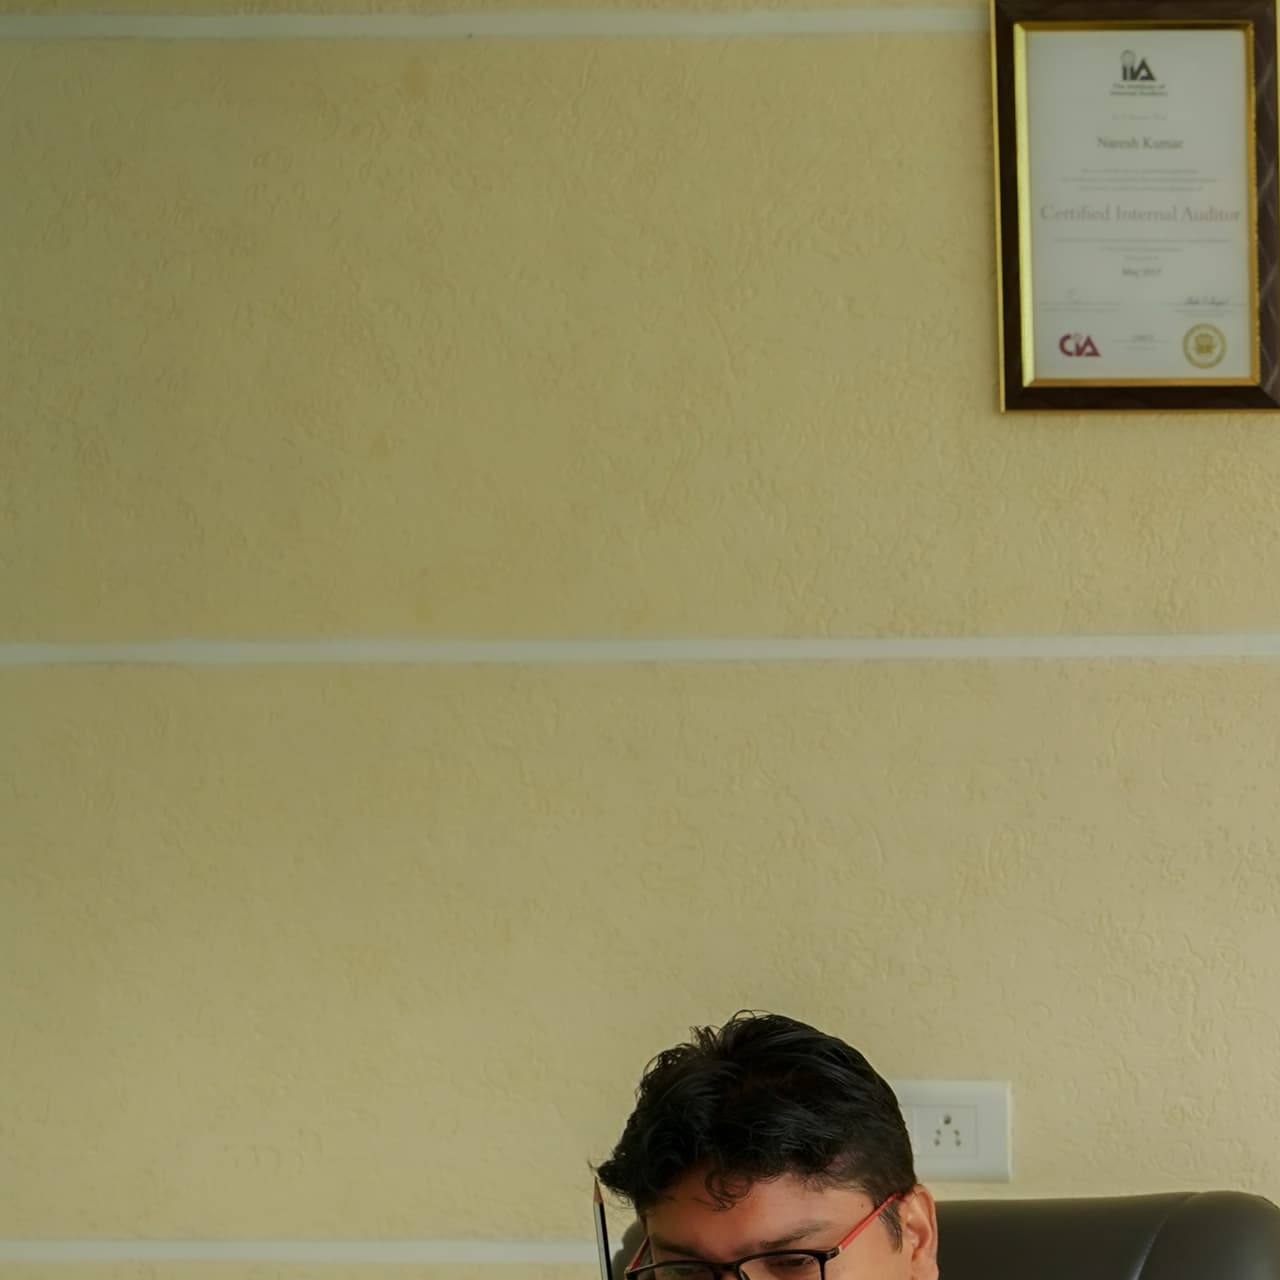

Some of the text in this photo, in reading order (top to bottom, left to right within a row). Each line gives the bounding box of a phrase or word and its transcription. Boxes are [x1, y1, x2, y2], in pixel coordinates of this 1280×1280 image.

[1040, 203, 1241, 222] Certified Internal Auditor
